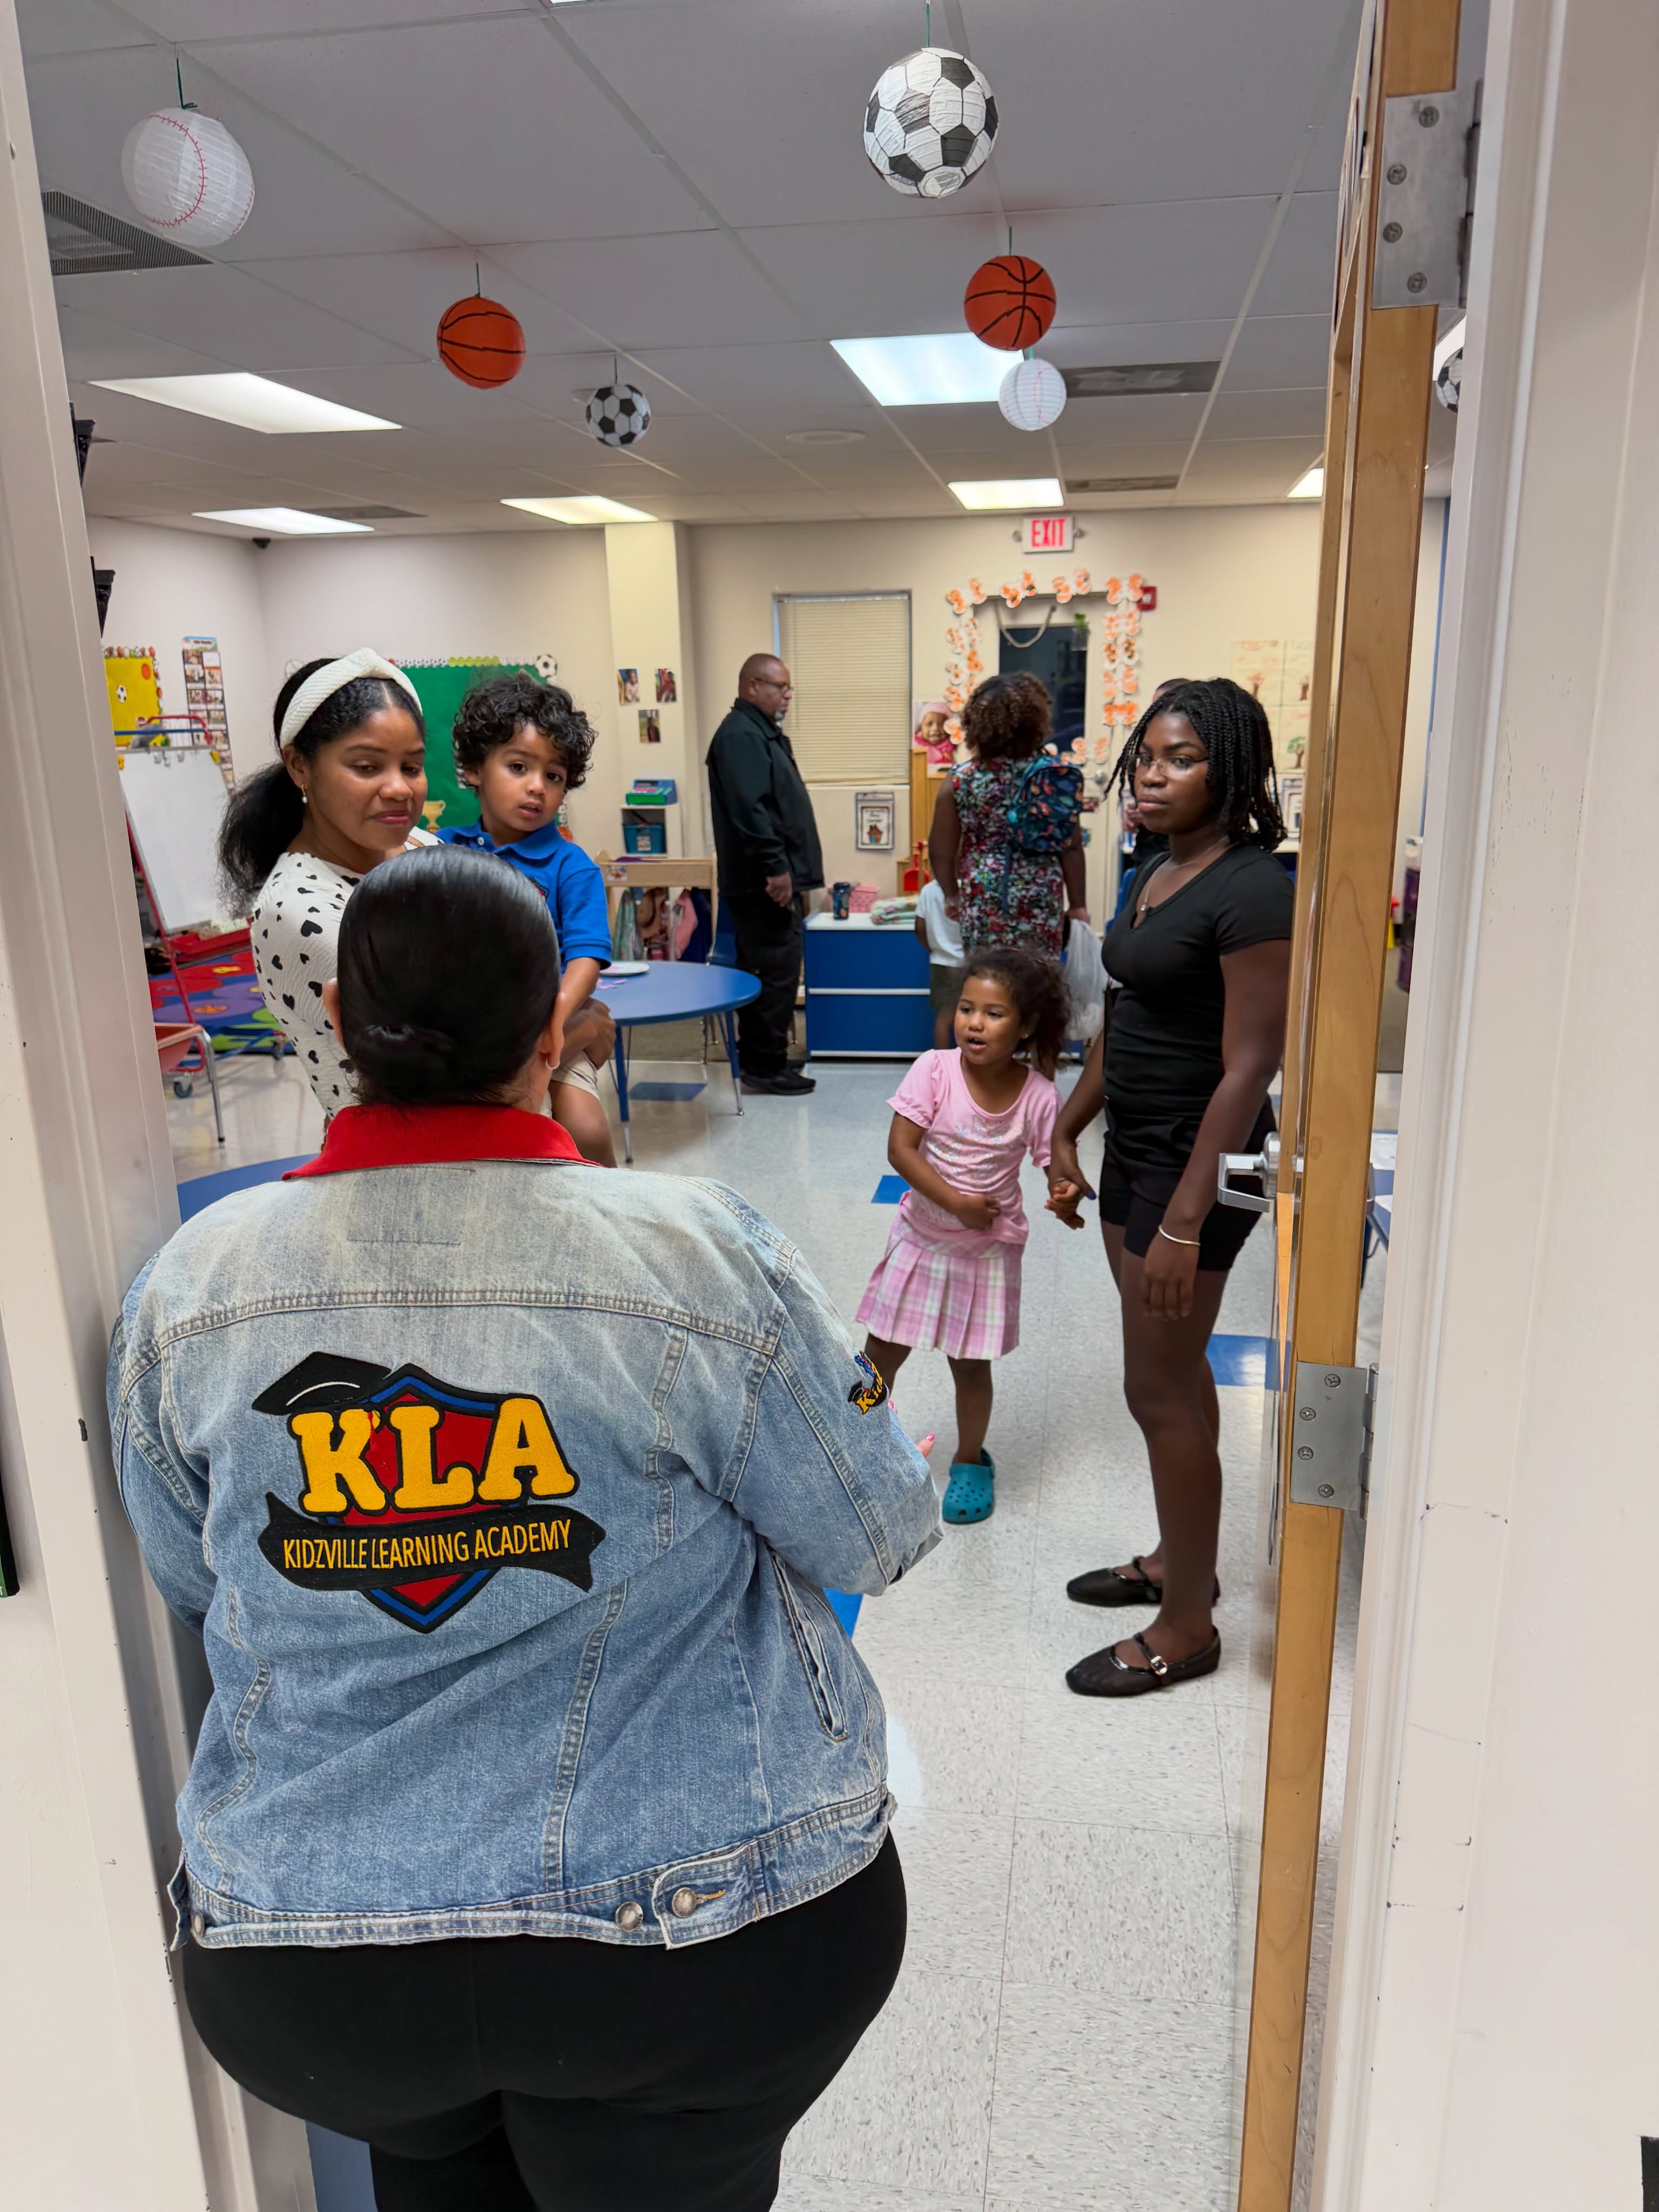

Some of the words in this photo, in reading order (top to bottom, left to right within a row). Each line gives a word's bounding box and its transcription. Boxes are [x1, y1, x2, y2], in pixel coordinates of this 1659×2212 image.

[1031, 518, 1066, 548] EXIT
[291, 1398, 575, 1512] KLA
[284, 1539, 367, 1569] KIDZVILLE
[371, 1532, 469, 1569] LEARNING
[474, 1519, 571, 1560] ACADEMY
